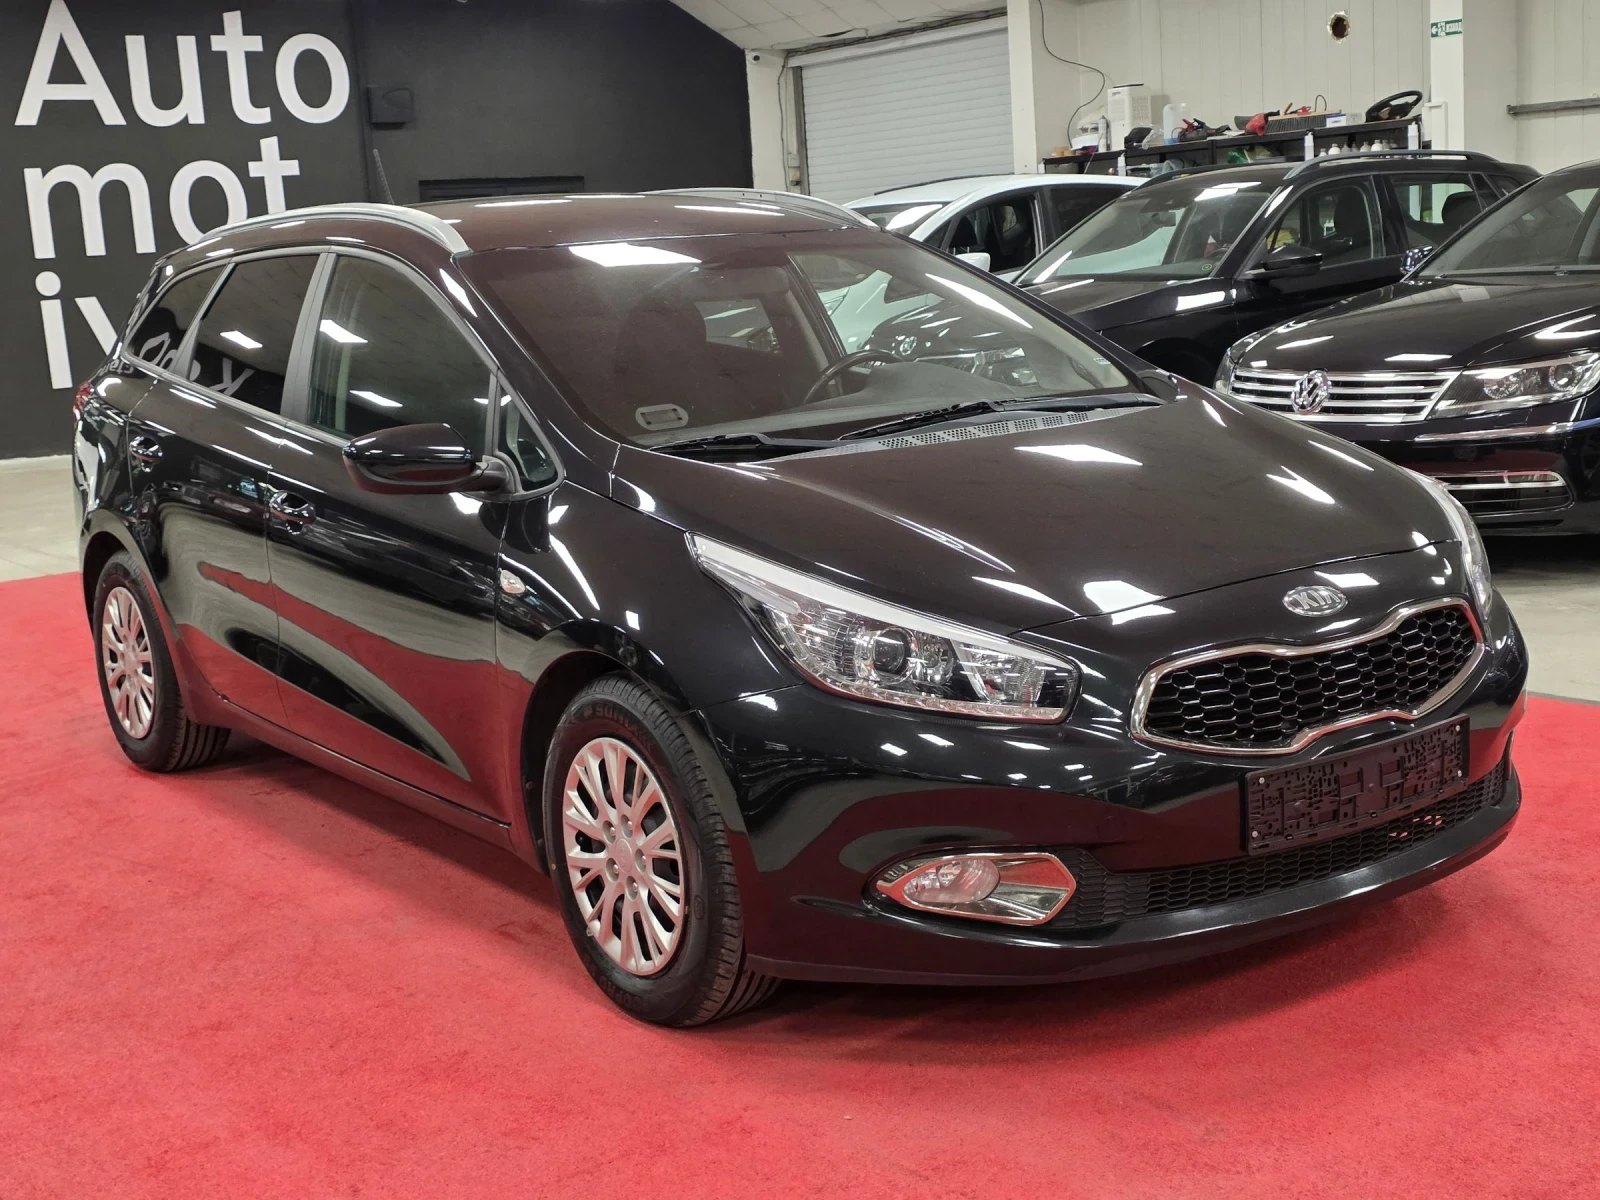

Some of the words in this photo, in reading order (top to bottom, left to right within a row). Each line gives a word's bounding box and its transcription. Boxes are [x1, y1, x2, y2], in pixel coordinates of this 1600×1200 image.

[14, 0, 350, 127] Auto
[23, 135, 301, 260] mot
[1291, 588, 1342, 611] KIA
